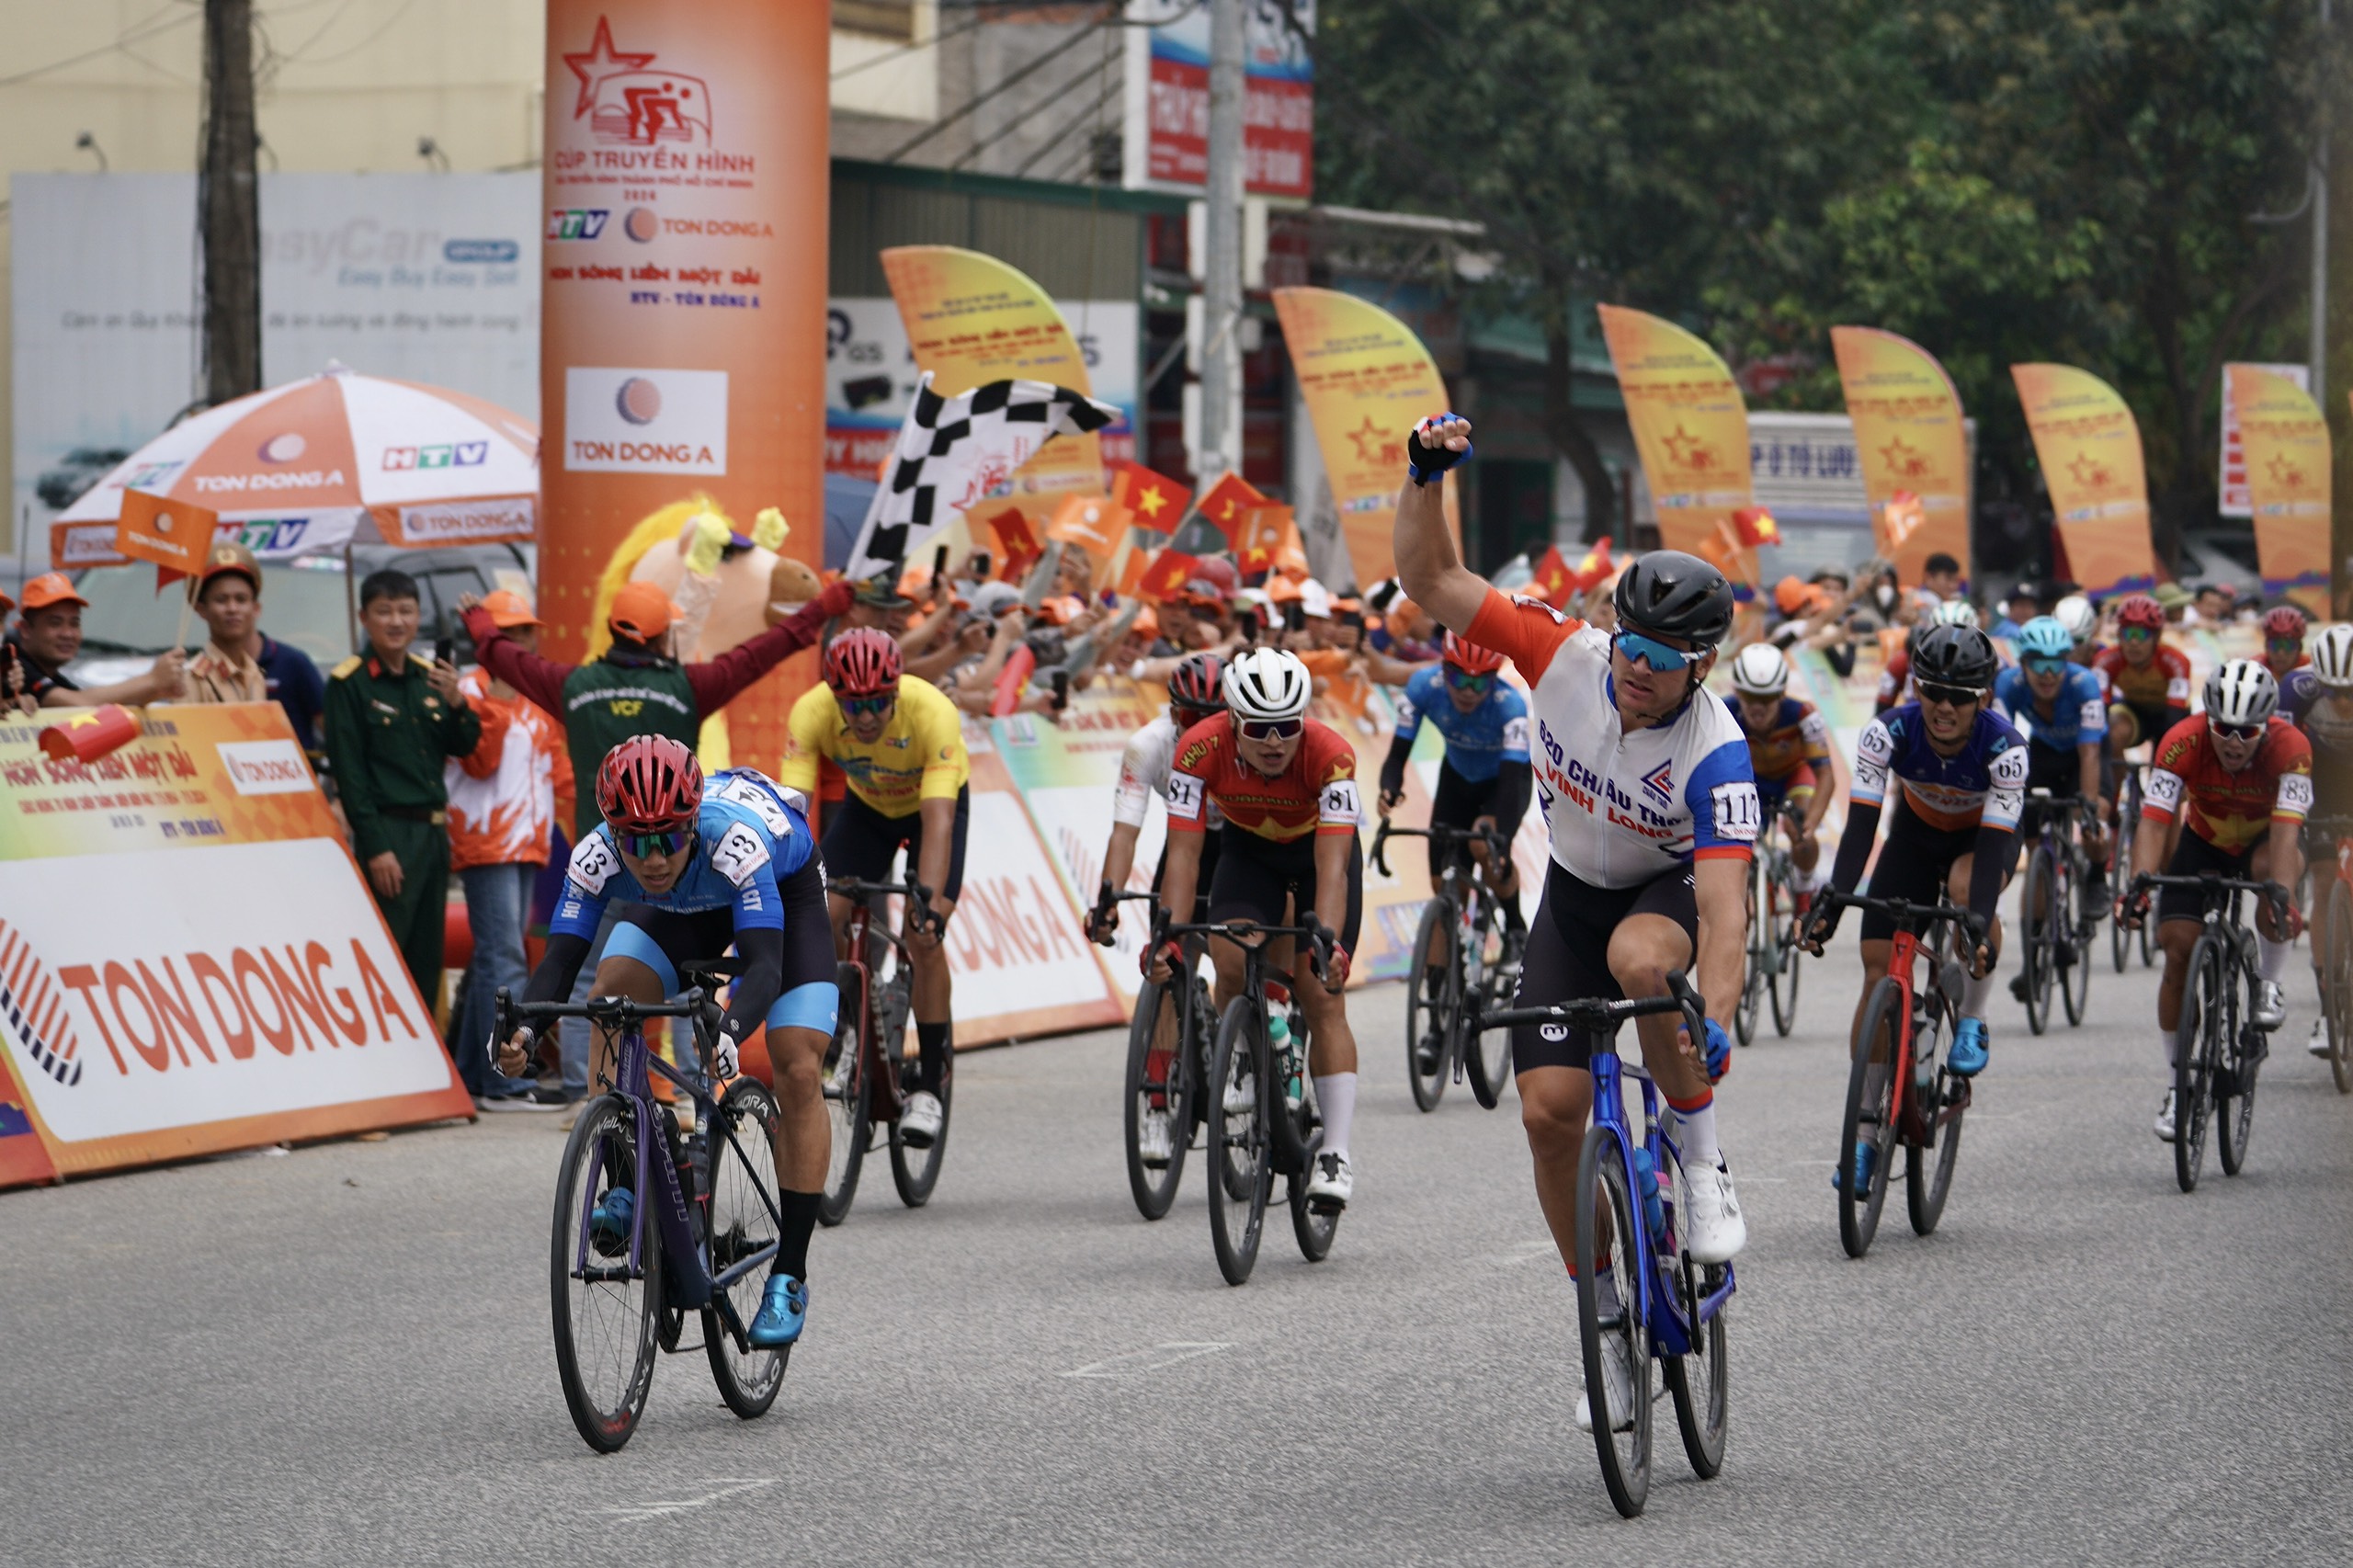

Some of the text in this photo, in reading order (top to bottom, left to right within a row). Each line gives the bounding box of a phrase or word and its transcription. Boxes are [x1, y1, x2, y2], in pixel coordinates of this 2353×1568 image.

[663, 218, 702, 235] TON
[706, 220, 759, 236] DONG
[382, 441, 489, 472] HTV
[573, 440, 714, 464] TON DONG A
[194, 469, 345, 493] TON DONG A
[428, 511, 529, 531] TON DONG A
[609, 699, 644, 717] VCF
[1180, 735, 1220, 770] KHU 7
[1862, 726, 1885, 754] 65
[2163, 739, 2188, 765] KHU
[1540, 719, 1564, 767] 620
[1567, 758, 1631, 811] CHÂU
[1167, 778, 1191, 806] 81
[1328, 789, 1355, 812] 81
[2151, 775, 2177, 800] 83
[2285, 779, 2310, 804] 83
[574, 843, 608, 876] 13
[724, 834, 757, 867] 13
[561, 900, 582, 920] HO
[1028, 873, 1082, 960] A
[58, 937, 421, 1076] TON DONG A
